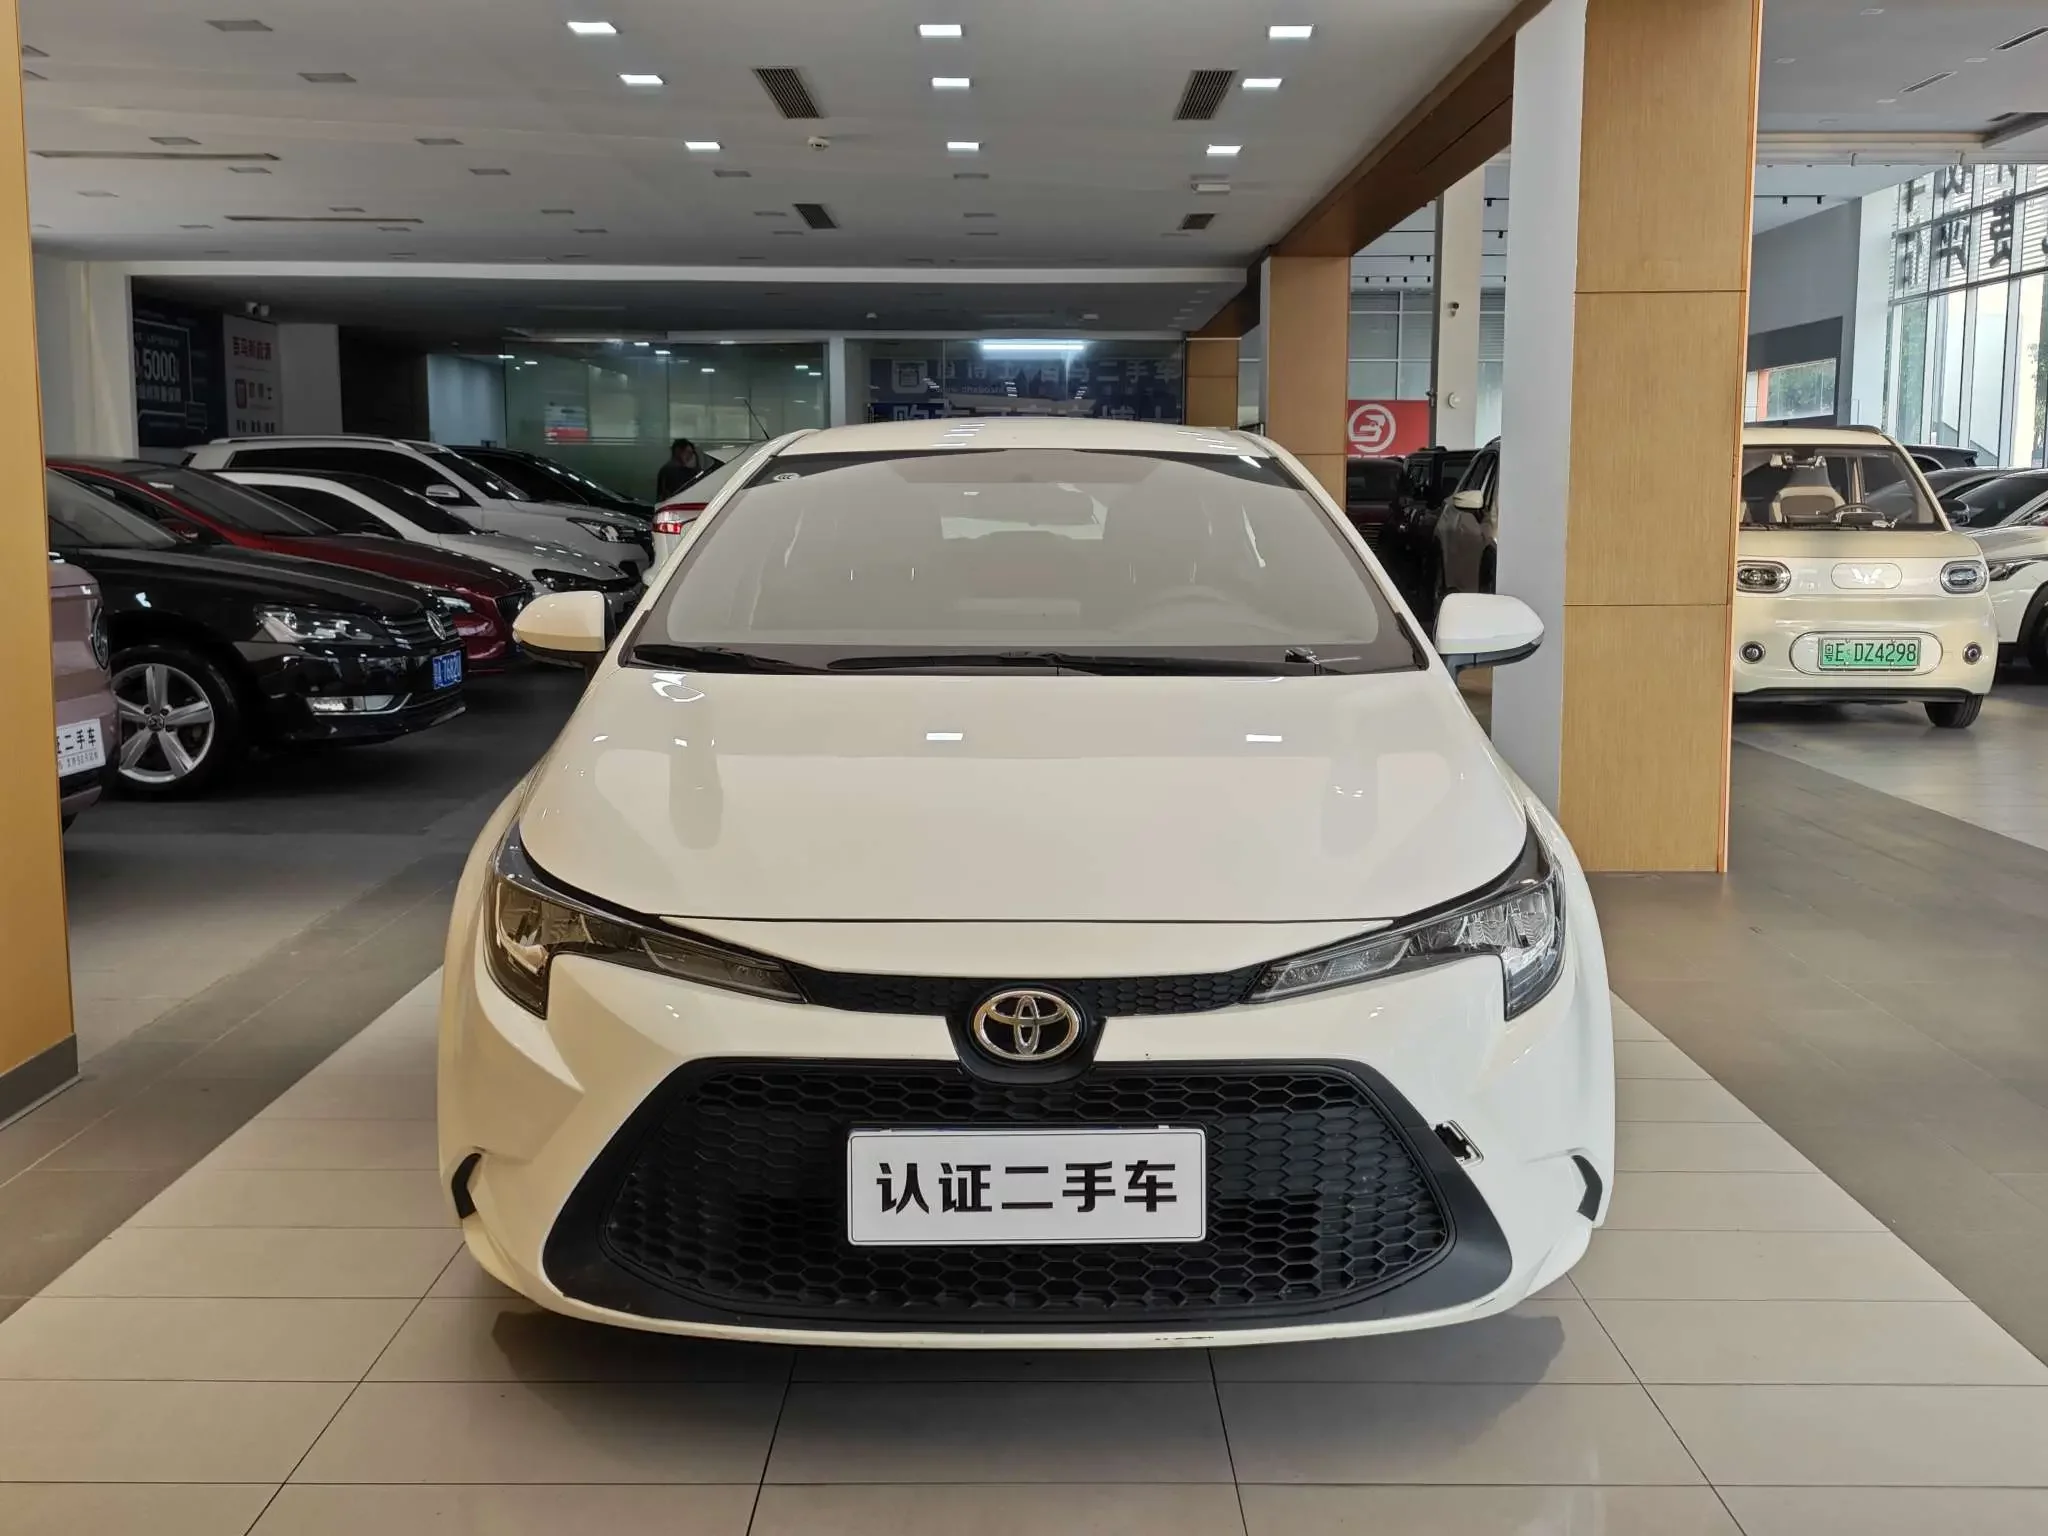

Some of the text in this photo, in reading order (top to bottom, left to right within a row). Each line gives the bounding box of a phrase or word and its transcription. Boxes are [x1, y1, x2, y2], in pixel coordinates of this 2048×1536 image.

[876, 1160, 1177, 1214] 认证二手车
